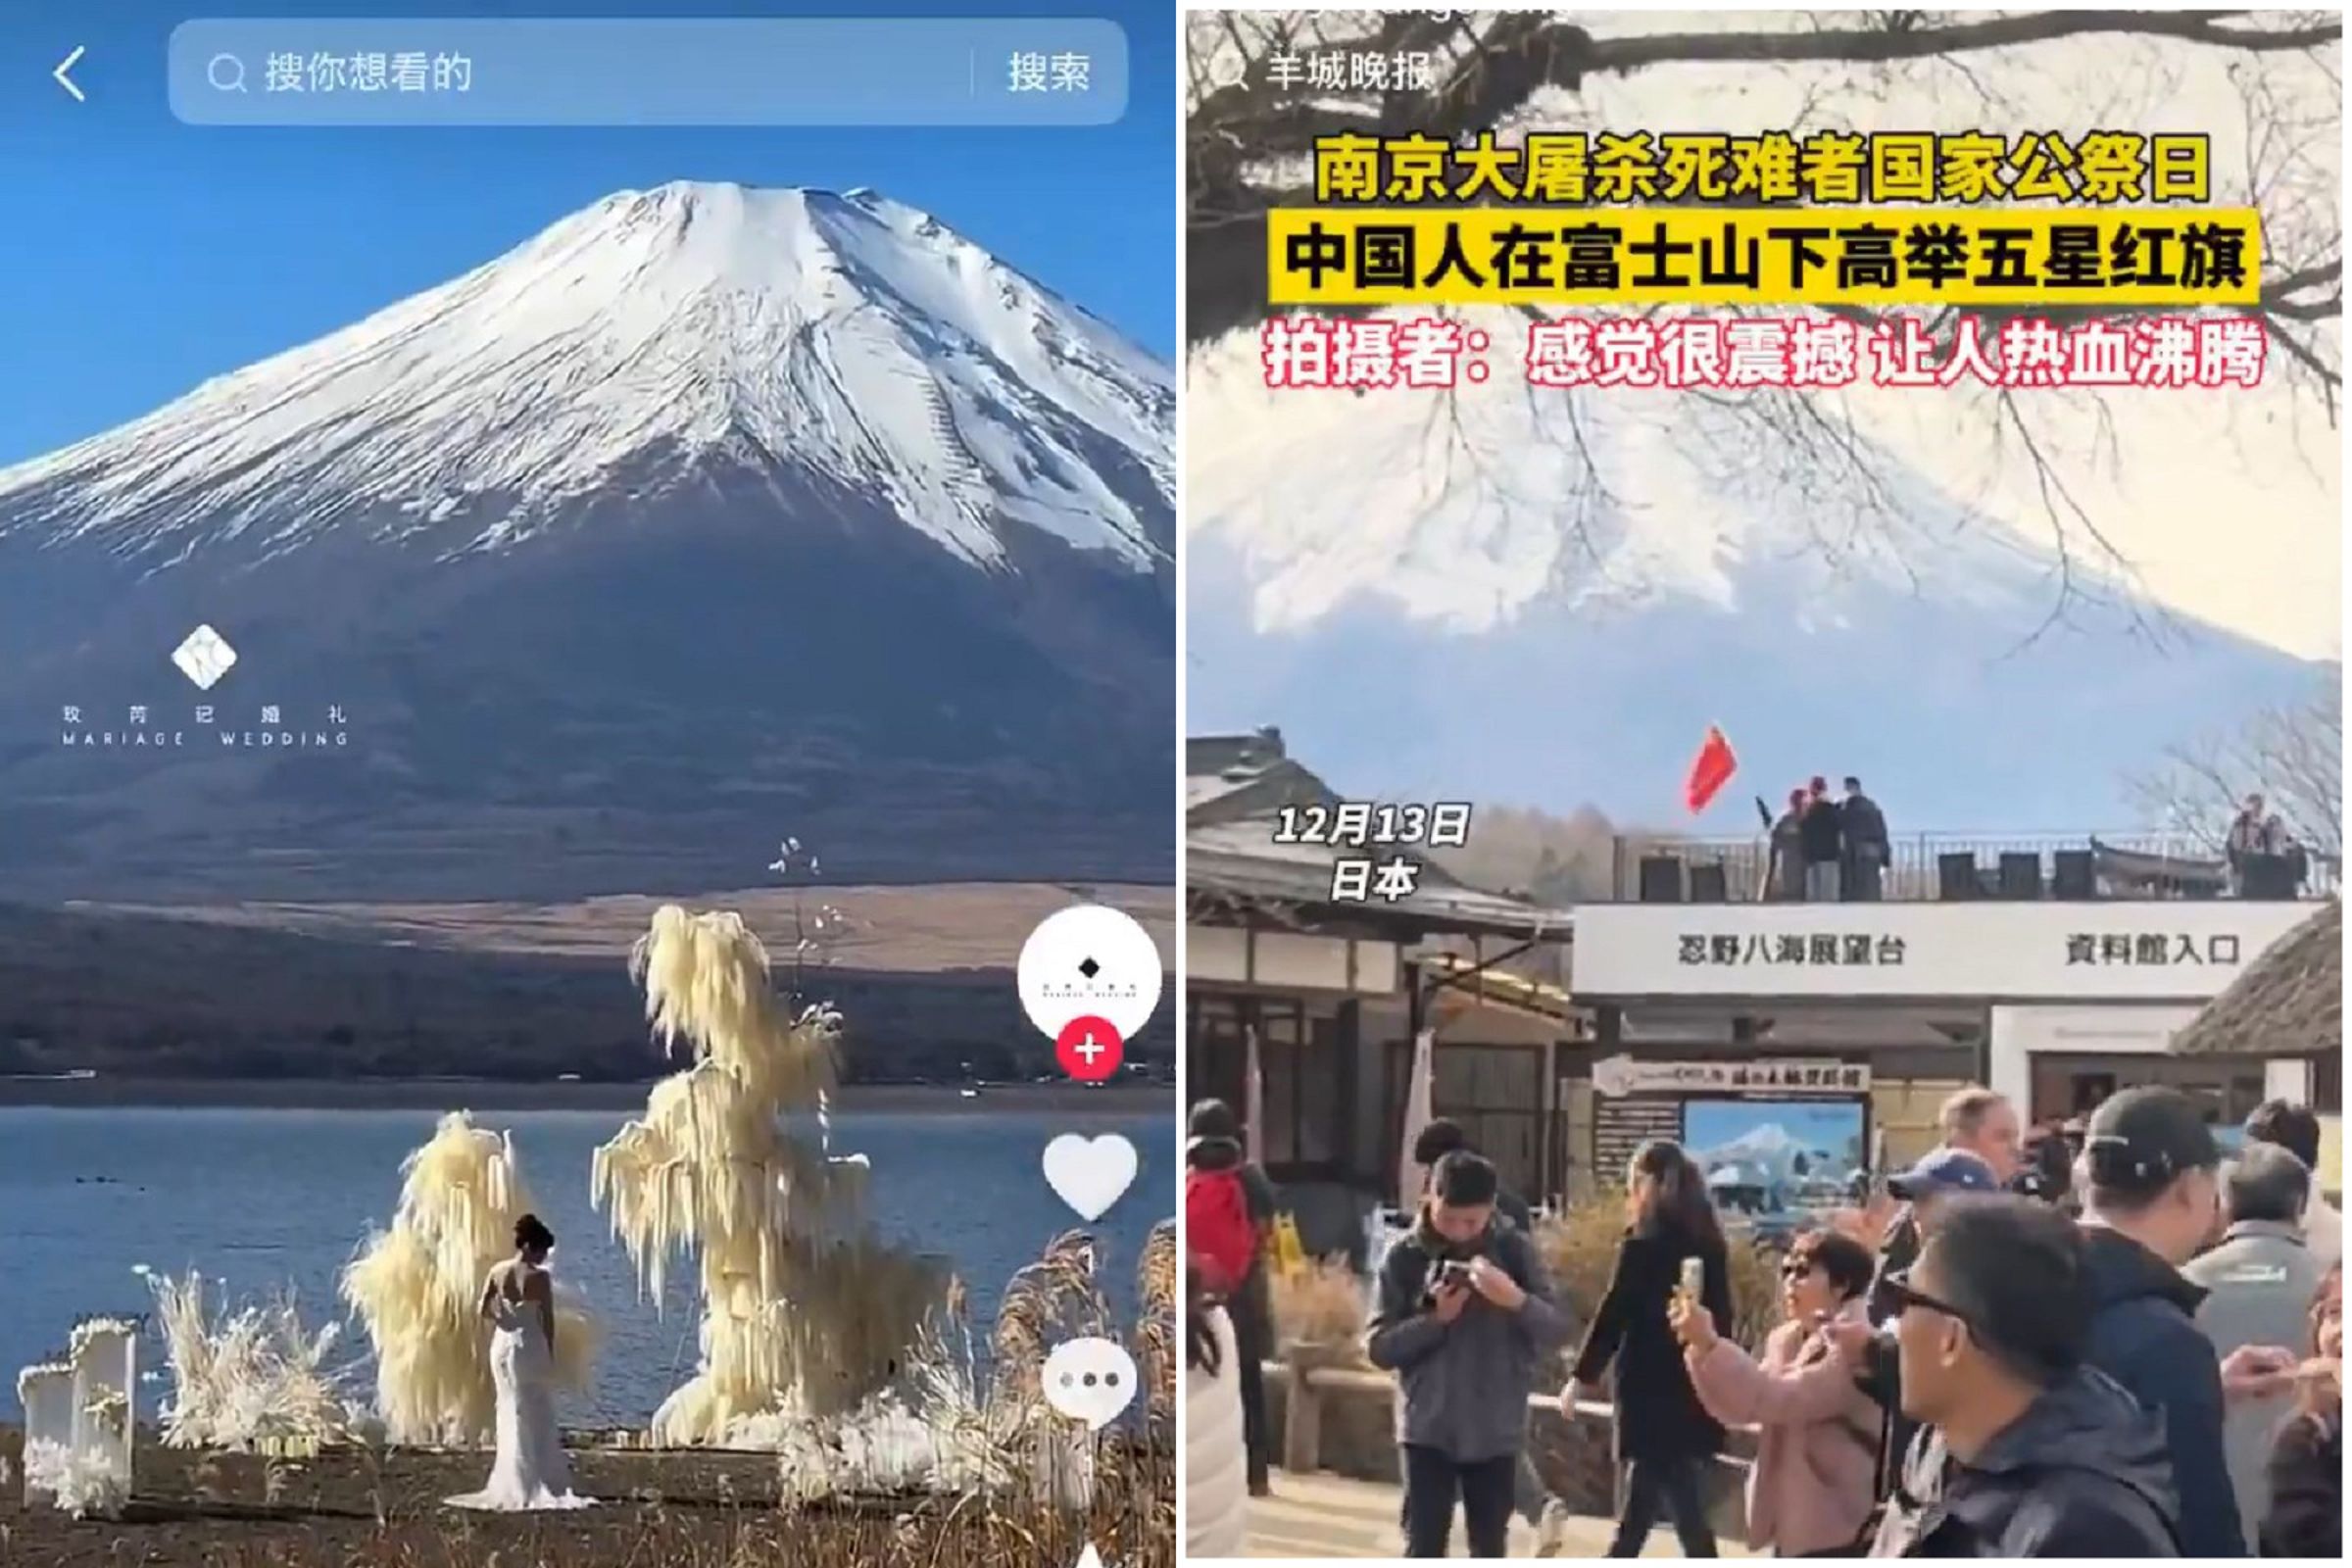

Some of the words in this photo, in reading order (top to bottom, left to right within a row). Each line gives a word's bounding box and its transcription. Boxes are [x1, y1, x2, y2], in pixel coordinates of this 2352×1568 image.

[1677, 932, 1907, 965] 忍野八海展望台
[2065, 932, 2240, 965] 資料館入口
